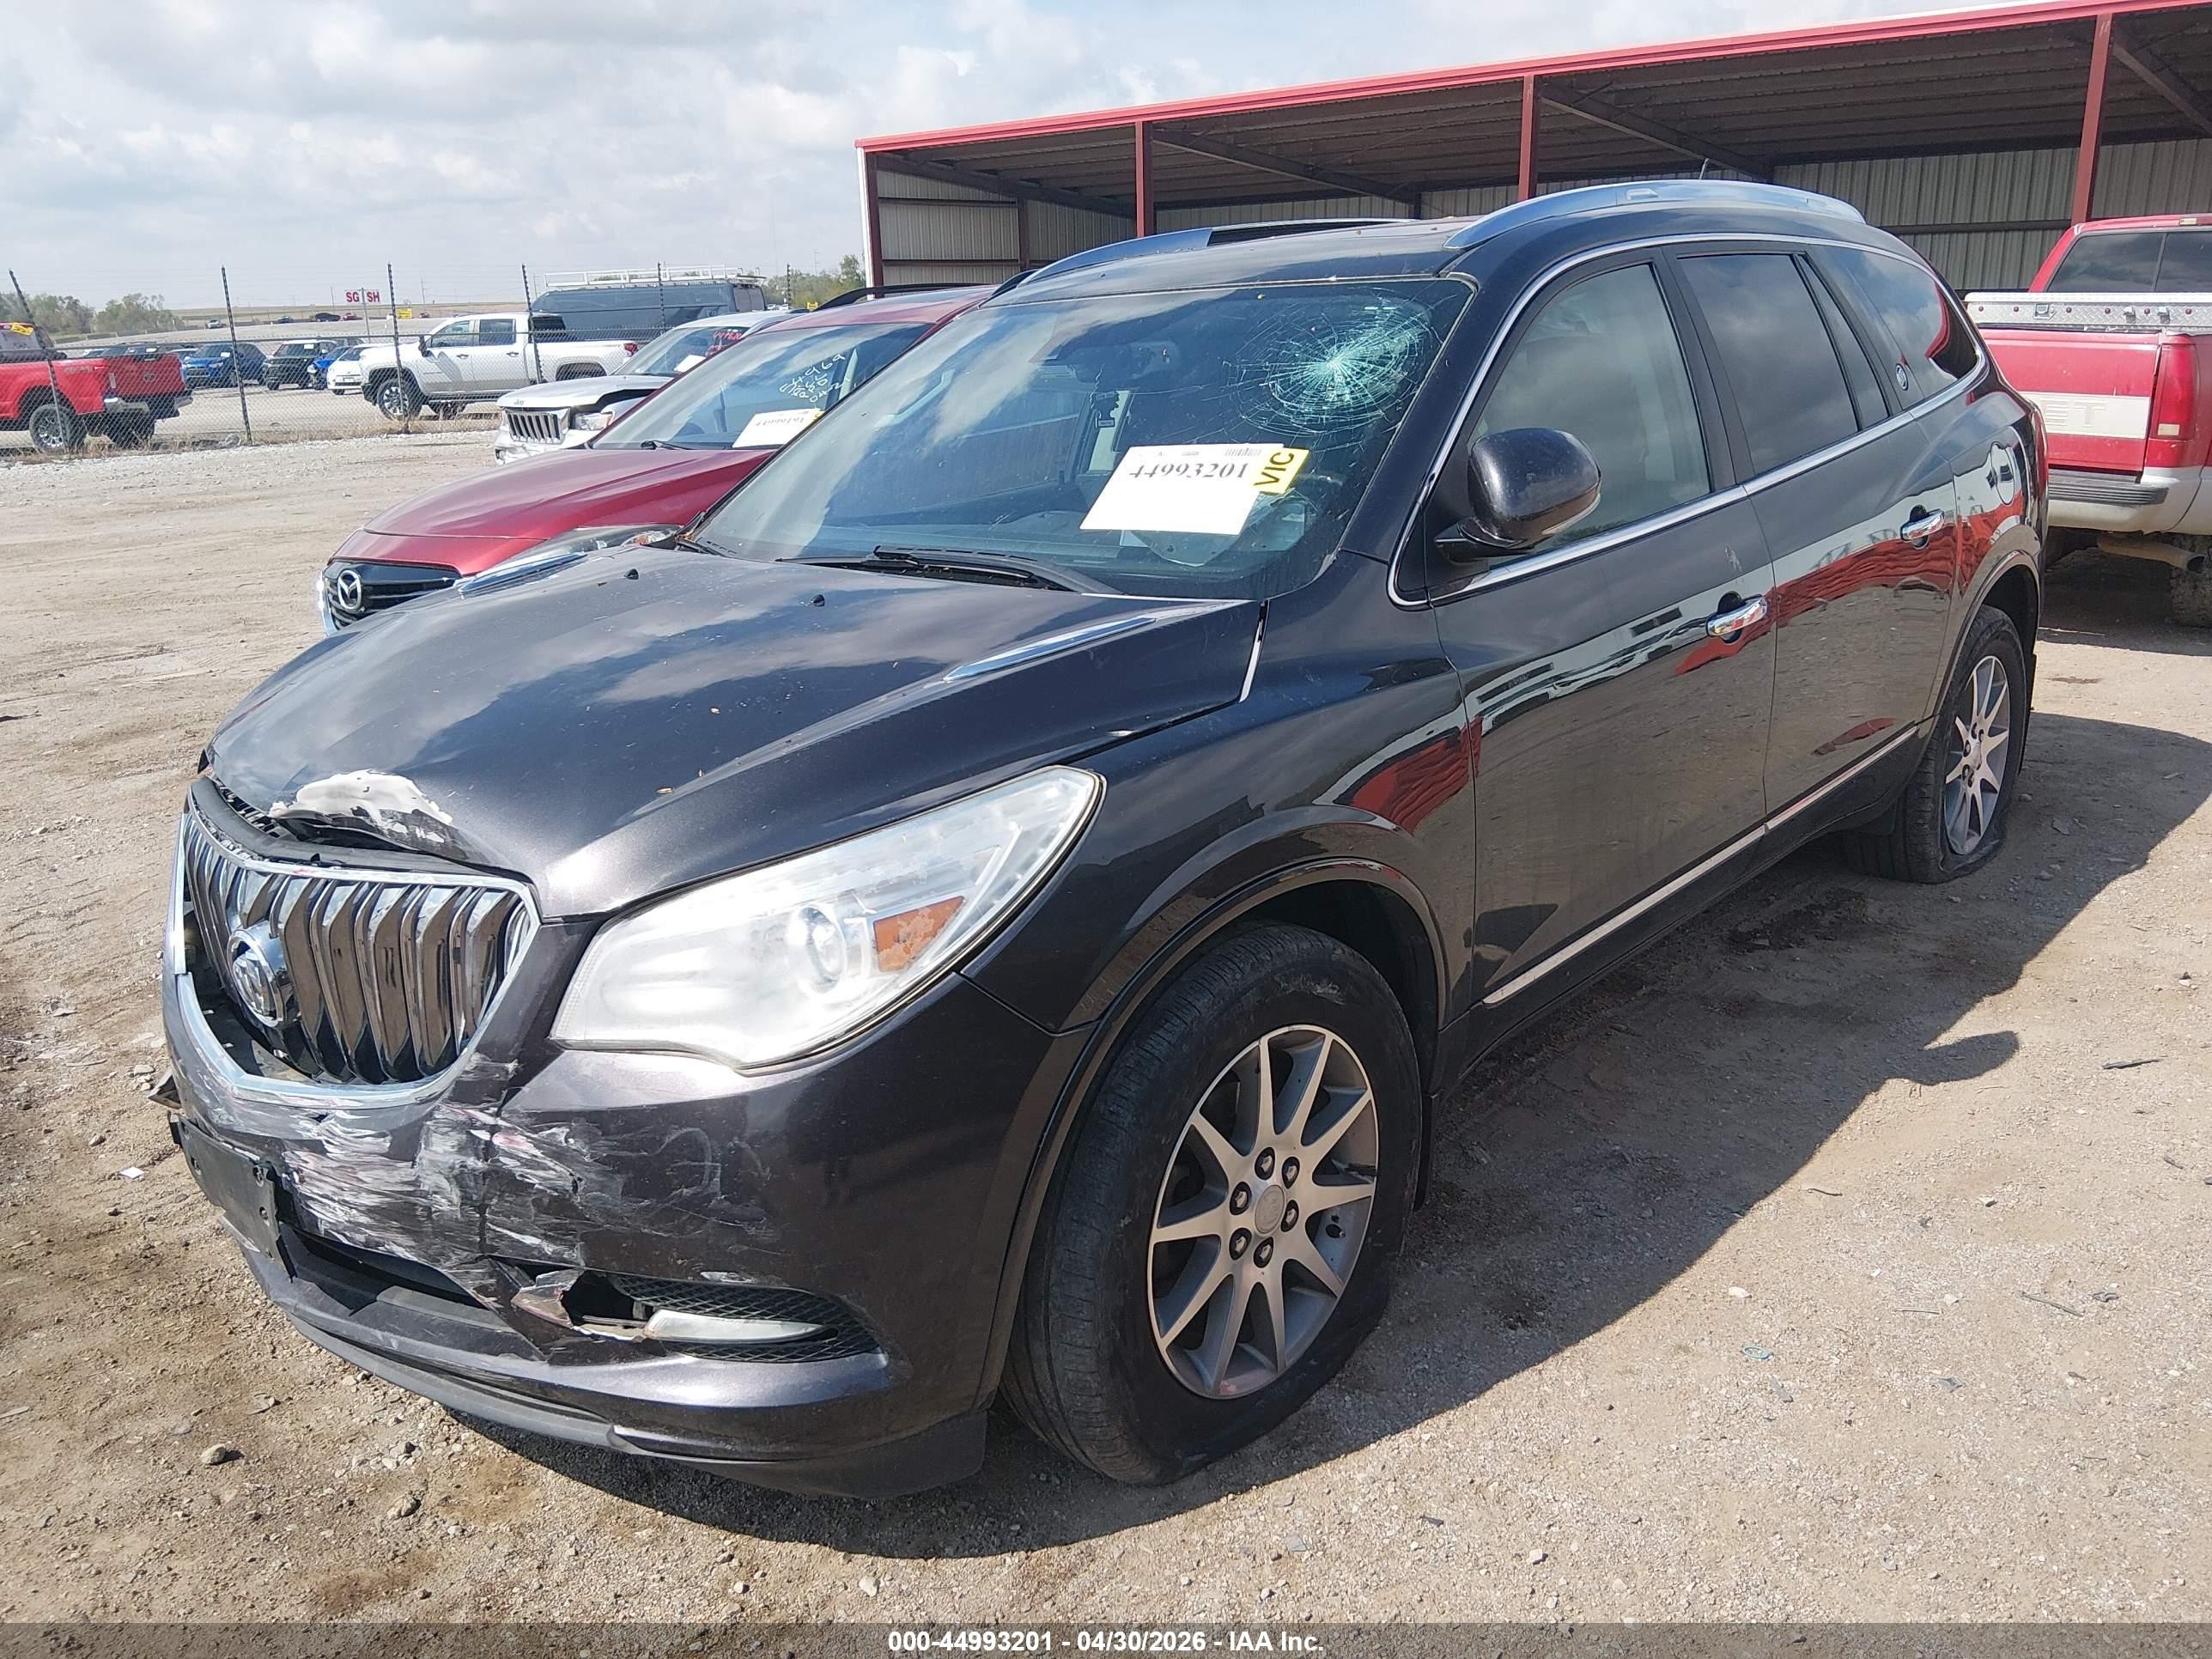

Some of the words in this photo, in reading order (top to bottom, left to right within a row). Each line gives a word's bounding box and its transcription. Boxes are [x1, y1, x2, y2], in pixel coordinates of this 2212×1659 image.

[345, 291, 360, 302] SG
[366, 291, 380, 302] SH
[1129, 463, 1249, 479] 44993201
[1252, 451, 1295, 486] VIC
